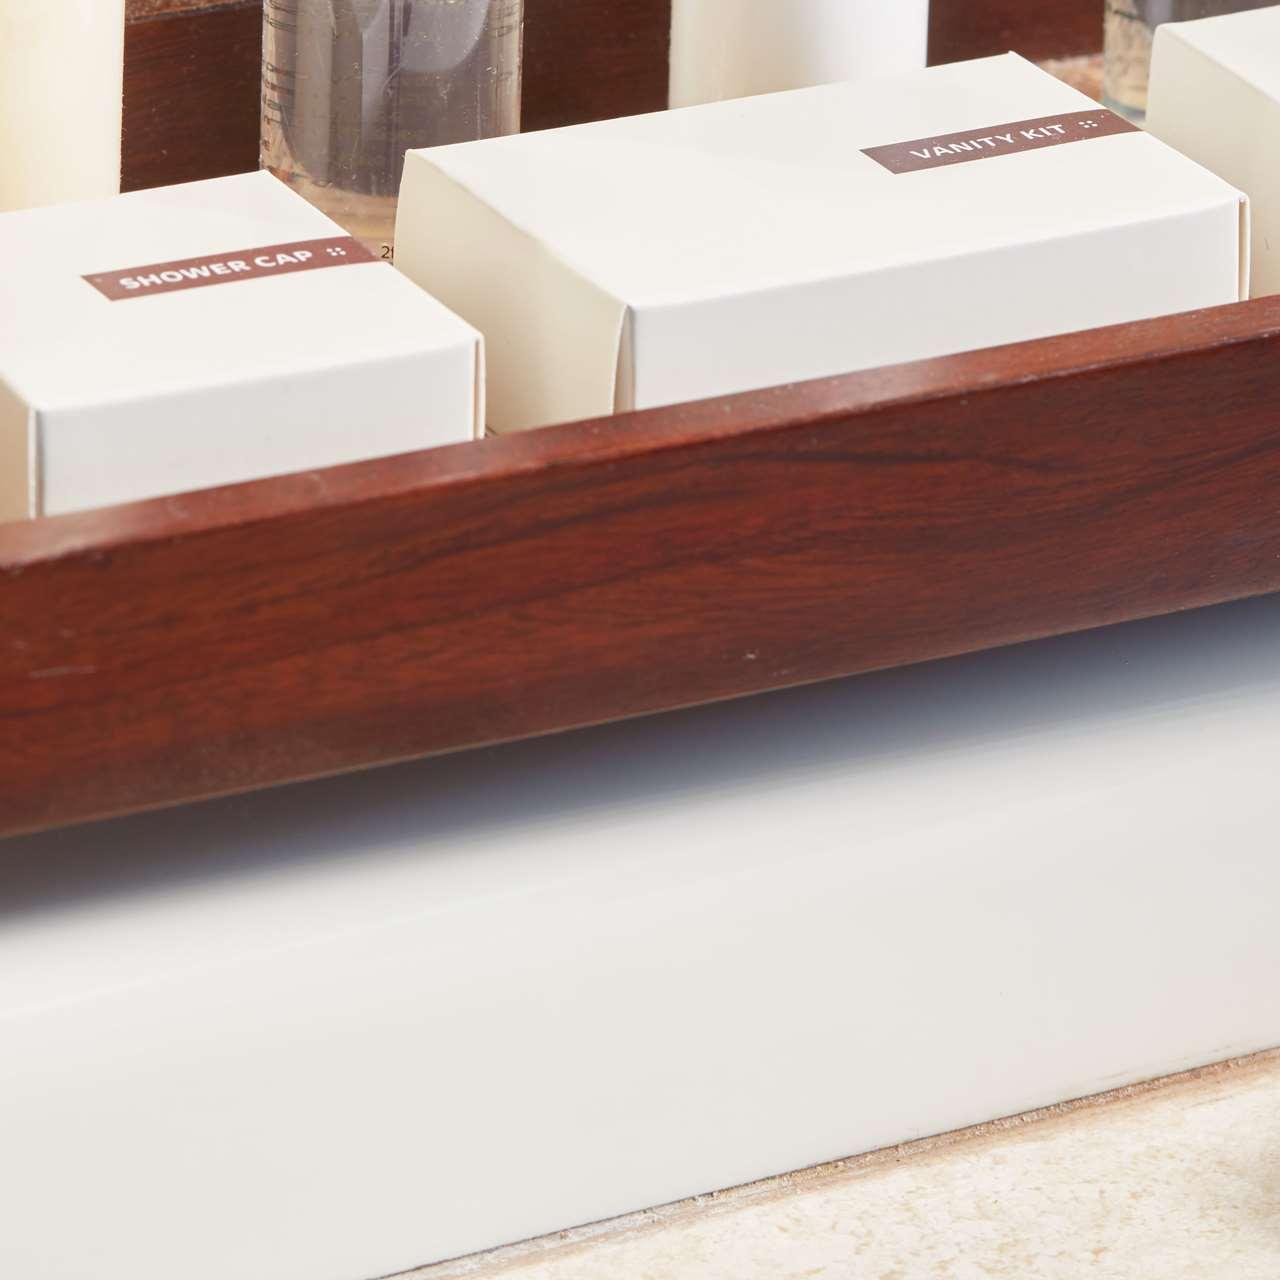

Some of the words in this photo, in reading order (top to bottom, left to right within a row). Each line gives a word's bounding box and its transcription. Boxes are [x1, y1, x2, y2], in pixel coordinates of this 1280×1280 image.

[909, 132, 1015, 160] VANITY
[1020, 123, 1067, 140] KIT
[119, 260, 252, 290] SHOWER
[253, 250, 314, 268] CAP
